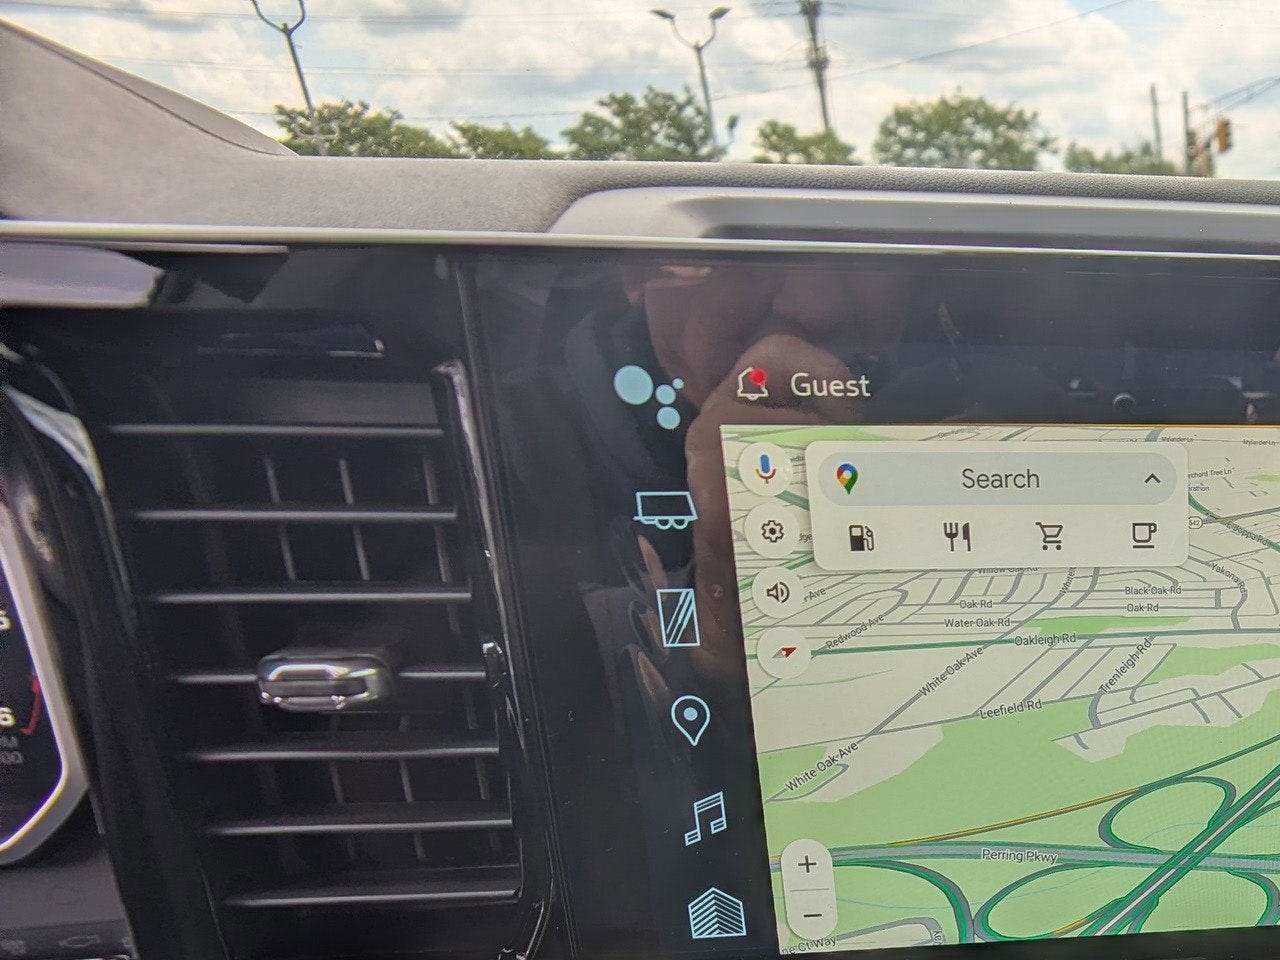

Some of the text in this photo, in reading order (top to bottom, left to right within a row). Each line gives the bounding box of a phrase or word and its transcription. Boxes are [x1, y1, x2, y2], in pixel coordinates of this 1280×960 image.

[790, 372, 871, 398] Guest
[962, 468, 1040, 488] Search
[1188, 470, 1208, 479] rchard
[1188, 484, 1210, 492] arathon
[1211, 563, 1247, 594] Yakona Rd
[808, 587, 827, 601] Ave
[1125, 586, 1182, 595] Black Oak Rd
[959, 599, 993, 609] Oak Rd
[1126, 603, 1159, 612] Oak Rd
[944, 618, 1011, 627] Water Oak Rd
[825, 613, 885, 650] Redwood Ave
[1014, 633, 1077, 647] Oakleigh Rd
[919, 646, 984, 697] White Oak Ave
[1099, 638, 1153, 693] Trenleigh Rd
[979, 699, 1043, 719] Leefield Rd
[785, 741, 859, 792] White Oak Ave
[982, 848, 1059, 865] Perring Pkwy
[797, 942, 811, 952] Ct
[814, 935, 837, 949] Way
